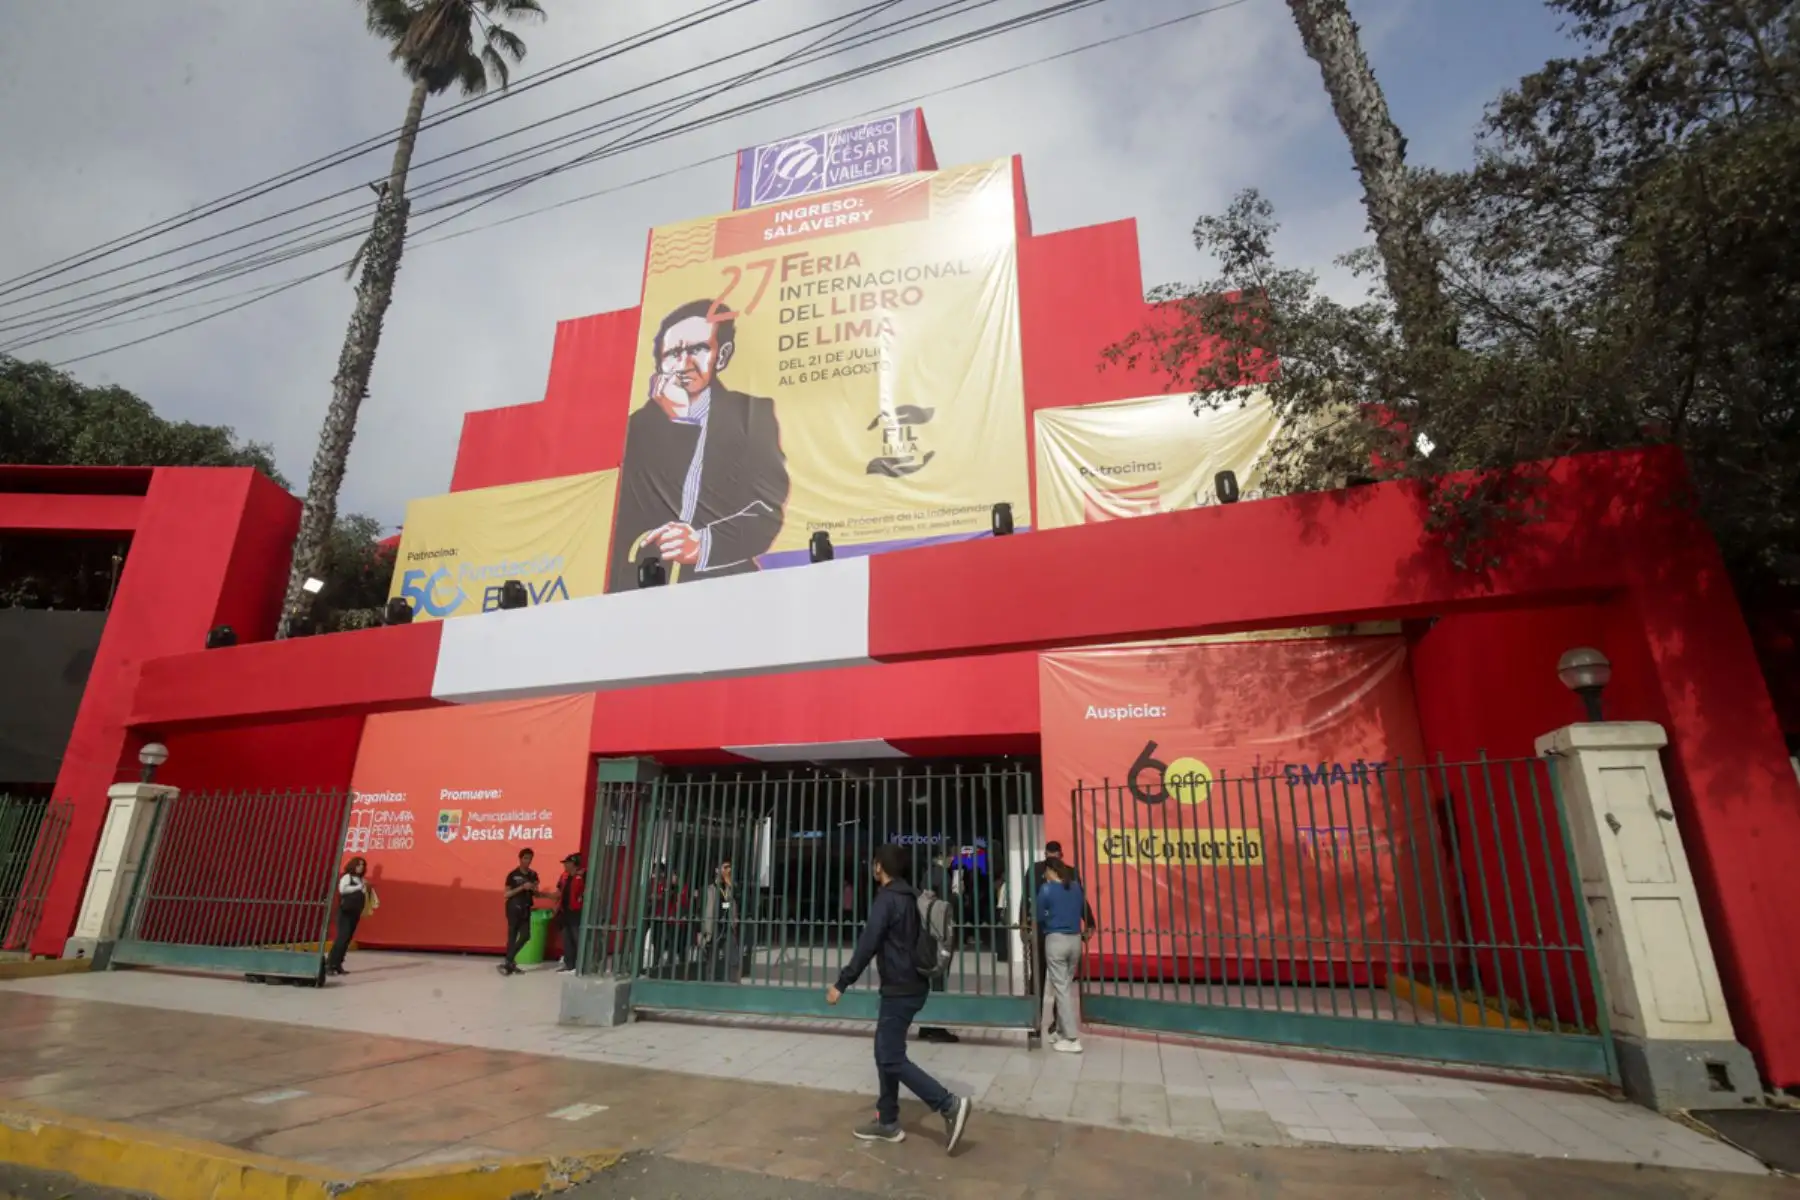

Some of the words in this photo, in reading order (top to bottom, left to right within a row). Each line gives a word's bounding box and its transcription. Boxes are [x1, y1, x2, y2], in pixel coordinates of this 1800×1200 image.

[828, 121, 896, 147] UNIVERSO
[828, 155, 893, 184] VALLEJO
[774, 197, 865, 224] INGRESO:
[763, 209, 874, 241] SALAVERRY
[706, 258, 777, 324] 27
[779, 259, 972, 302] INTERNACIONAL
[779, 303, 824, 325] DEL
[830, 286, 924, 316] LIBRO
[778, 331, 810, 352] DE
[815, 317, 896, 346] LIMA
[778, 359, 805, 372] DEL
[808, 354, 822, 367] 21
[825, 351, 845, 364] DE
[778, 375, 796, 387] AL
[799, 372, 808, 384] 6
[810, 368, 829, 382] DE
[831, 360, 892, 379] AGOSTO
[883, 425, 918, 444] FIL
[1085, 703, 1167, 721] Auspicia:
[440, 788, 503, 801] Promueve:
[467, 810, 537, 822] Municipalidad
[539, 808, 553, 820] de
[462, 824, 505, 841] Jesús
[508, 823, 553, 841] María
[1103, 834, 1134, 859] El
